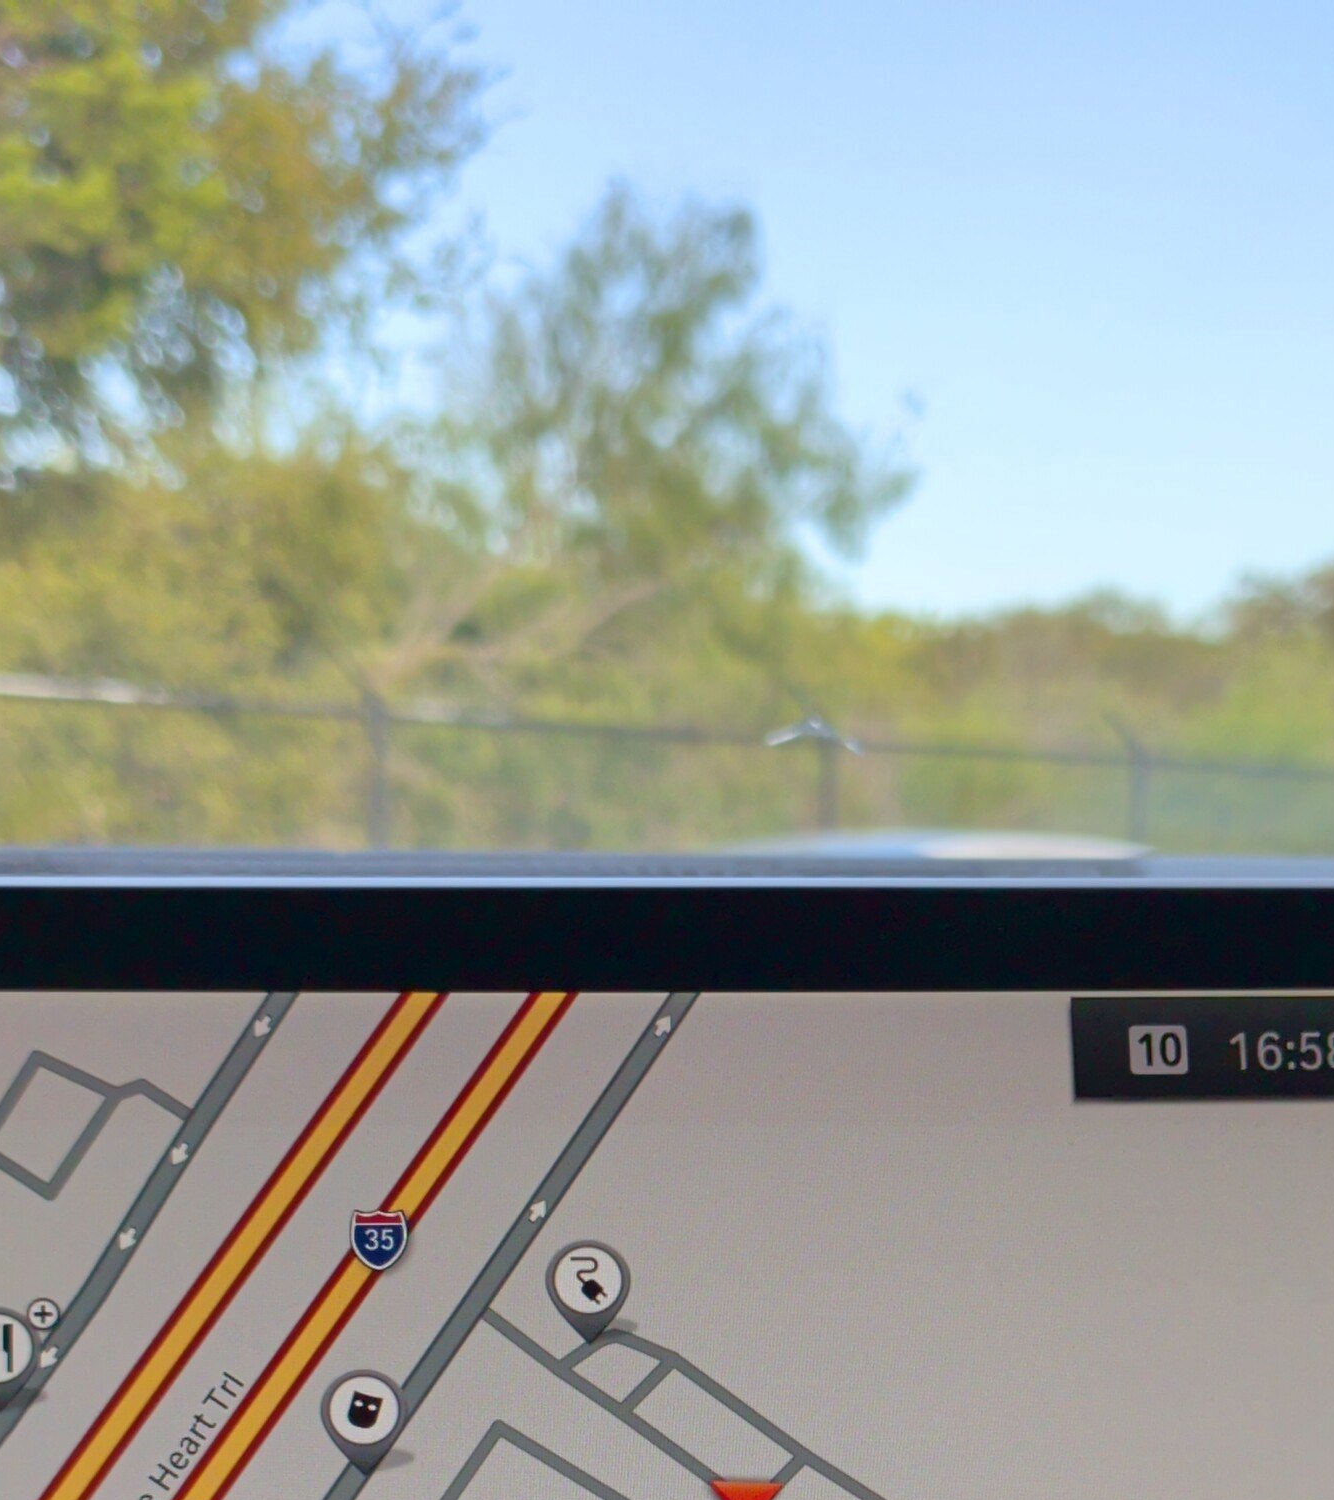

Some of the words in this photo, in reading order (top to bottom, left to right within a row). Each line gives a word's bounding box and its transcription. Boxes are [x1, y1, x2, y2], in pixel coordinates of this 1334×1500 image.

[1138, 1031, 1182, 1067] 10
[364, 1229, 394, 1251] 35
[148, 1413, 216, 1491] Heart
[203, 1371, 244, 1410] Trl
